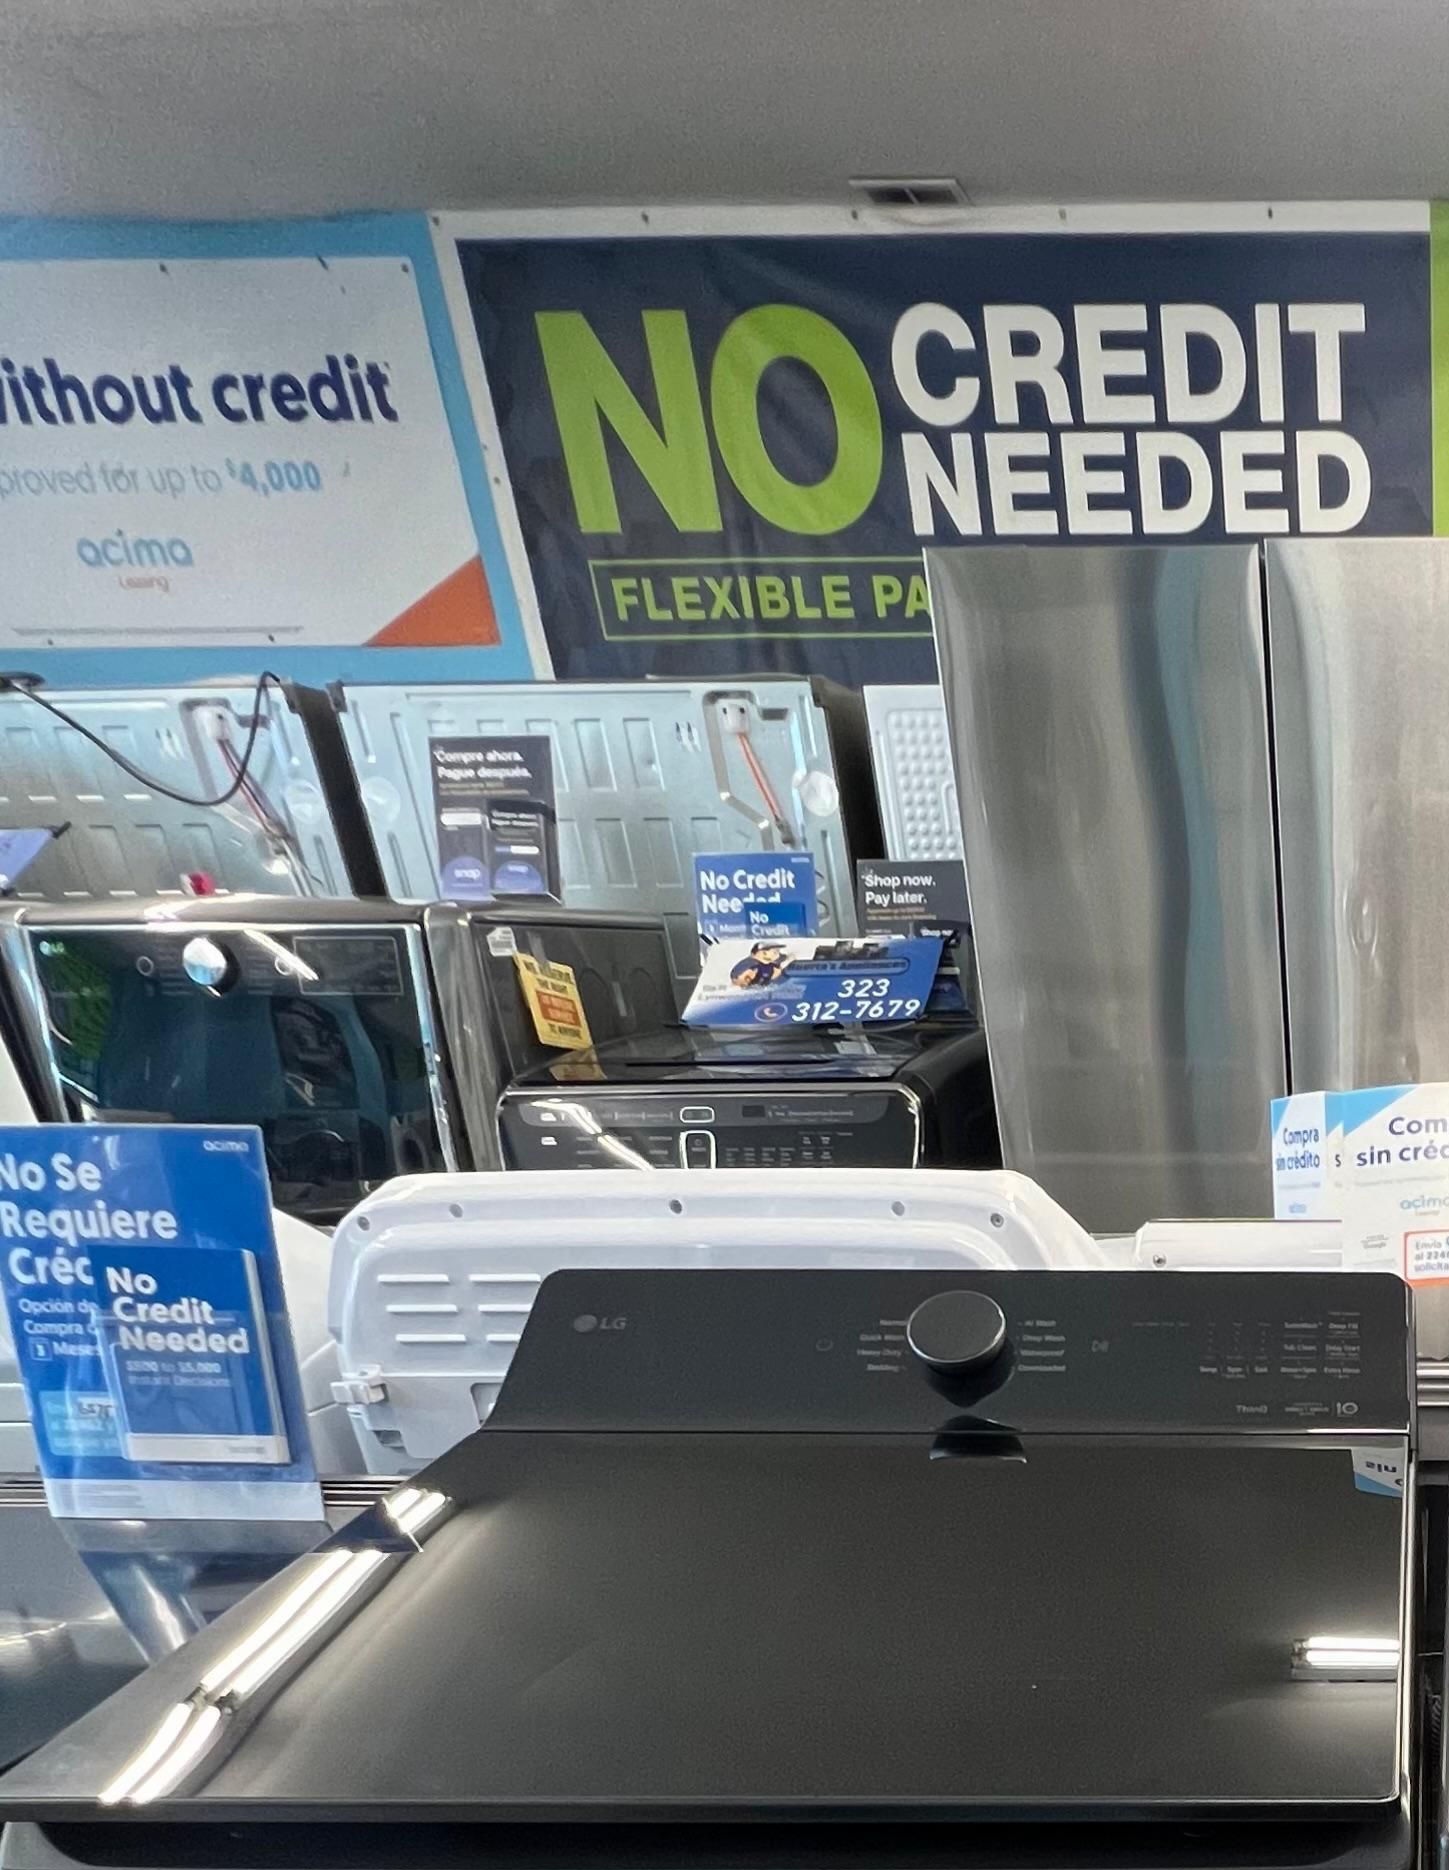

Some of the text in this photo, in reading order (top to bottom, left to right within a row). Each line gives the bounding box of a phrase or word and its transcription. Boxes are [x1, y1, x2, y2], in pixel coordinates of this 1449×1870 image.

[891, 301, 1367, 427] CREDIT
[211, 353, 400, 423] credit
[534, 303, 884, 536] NO
[100, 462, 141, 495] for
[148, 468, 186, 498] up
[190, 464, 222, 494] to
[225, 456, 323, 497] $4,000
[901, 430, 1372, 537] NEEDED
[76, 528, 194, 568] acima
[610, 574, 855, 621] FLEXIBLE
[700, 867, 796, 892] No Credit
[864, 873, 937, 891] Shop now.
[865, 890, 928, 908] Pay later.
[749, 910, 769, 924] No
[836, 978, 892, 999] 323
[790, 999, 921, 1022] 312-7679
[1283, 1127, 1320, 1147] Compra
[1287, 1149, 1320, 1170] crédito
[1356, 1145, 1392, 1167] sin
[54, 1152, 102, 1192] Se
[0, 1201, 179, 1247] Requiere
[105, 1266, 158, 1295] No
[18, 1298, 76, 1316] Opción
[112, 1296, 216, 1325] Credit
[23, 1319, 84, 1337] Compra
[600, 1316, 627, 1330] LG
[119, 1325, 250, 1354] Needed
